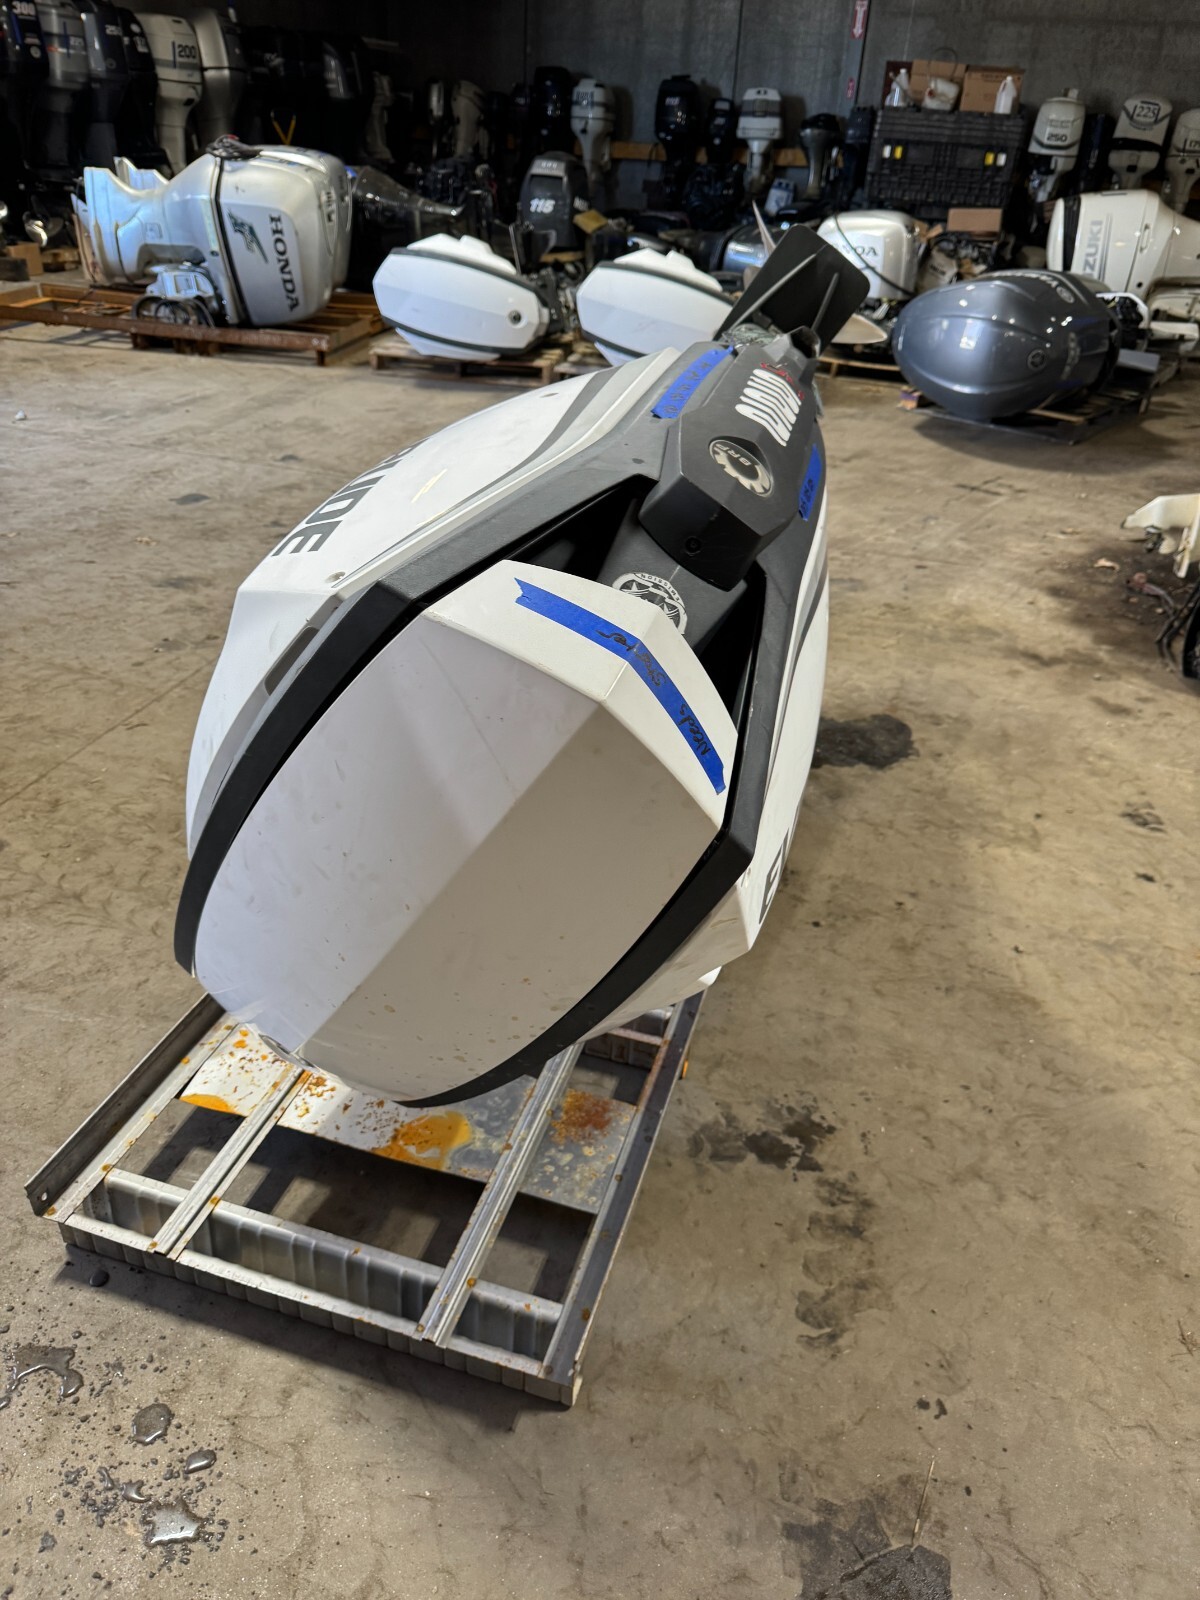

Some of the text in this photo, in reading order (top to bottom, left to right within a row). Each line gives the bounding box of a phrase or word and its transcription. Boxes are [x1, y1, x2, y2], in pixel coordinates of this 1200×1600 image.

[177, 45, 197, 59] 200
[1136, 105, 1157, 119] 225
[530, 198, 556, 213] 115
[269, 213, 300, 312] HONDA
[714, 443, 751, 466] BRP
[639, 572, 681, 602] EMISSION
[678, 702, 711, 756] Needs
